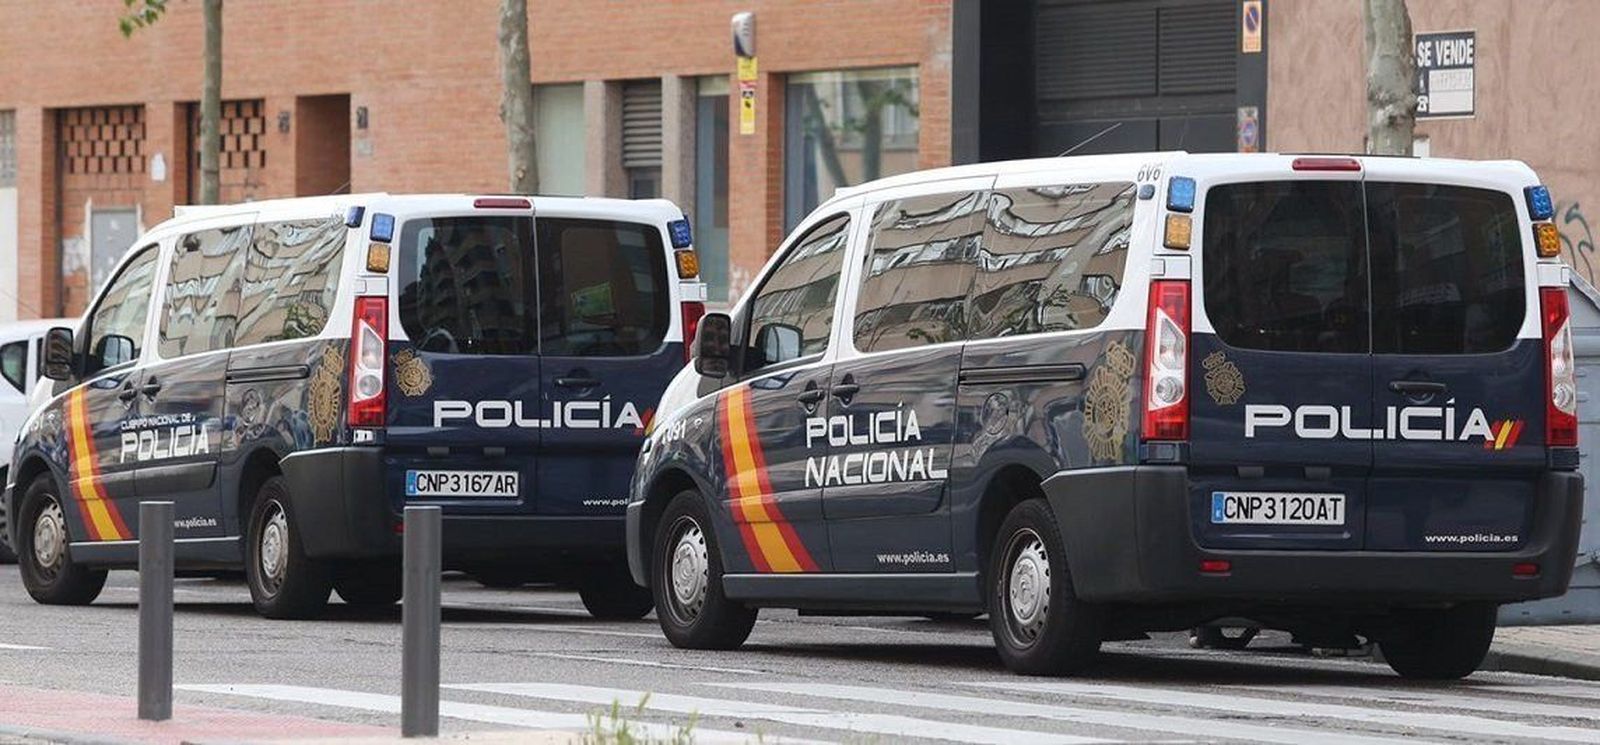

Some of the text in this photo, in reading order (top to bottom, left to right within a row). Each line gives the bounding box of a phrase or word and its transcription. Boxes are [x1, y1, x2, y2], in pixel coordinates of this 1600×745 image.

[1417, 38, 1474, 67] SE VENDE
[181, 412, 191, 423] DE
[433, 395, 644, 428] POLICÍA
[806, 401, 922, 449] POLICÍA
[1245, 397, 1495, 441] POLICÍA
[805, 448, 948, 488] NACIONAL
[1425, 533, 1519, 544] www.policia.es
[877, 551, 950, 566] www.policia.es
